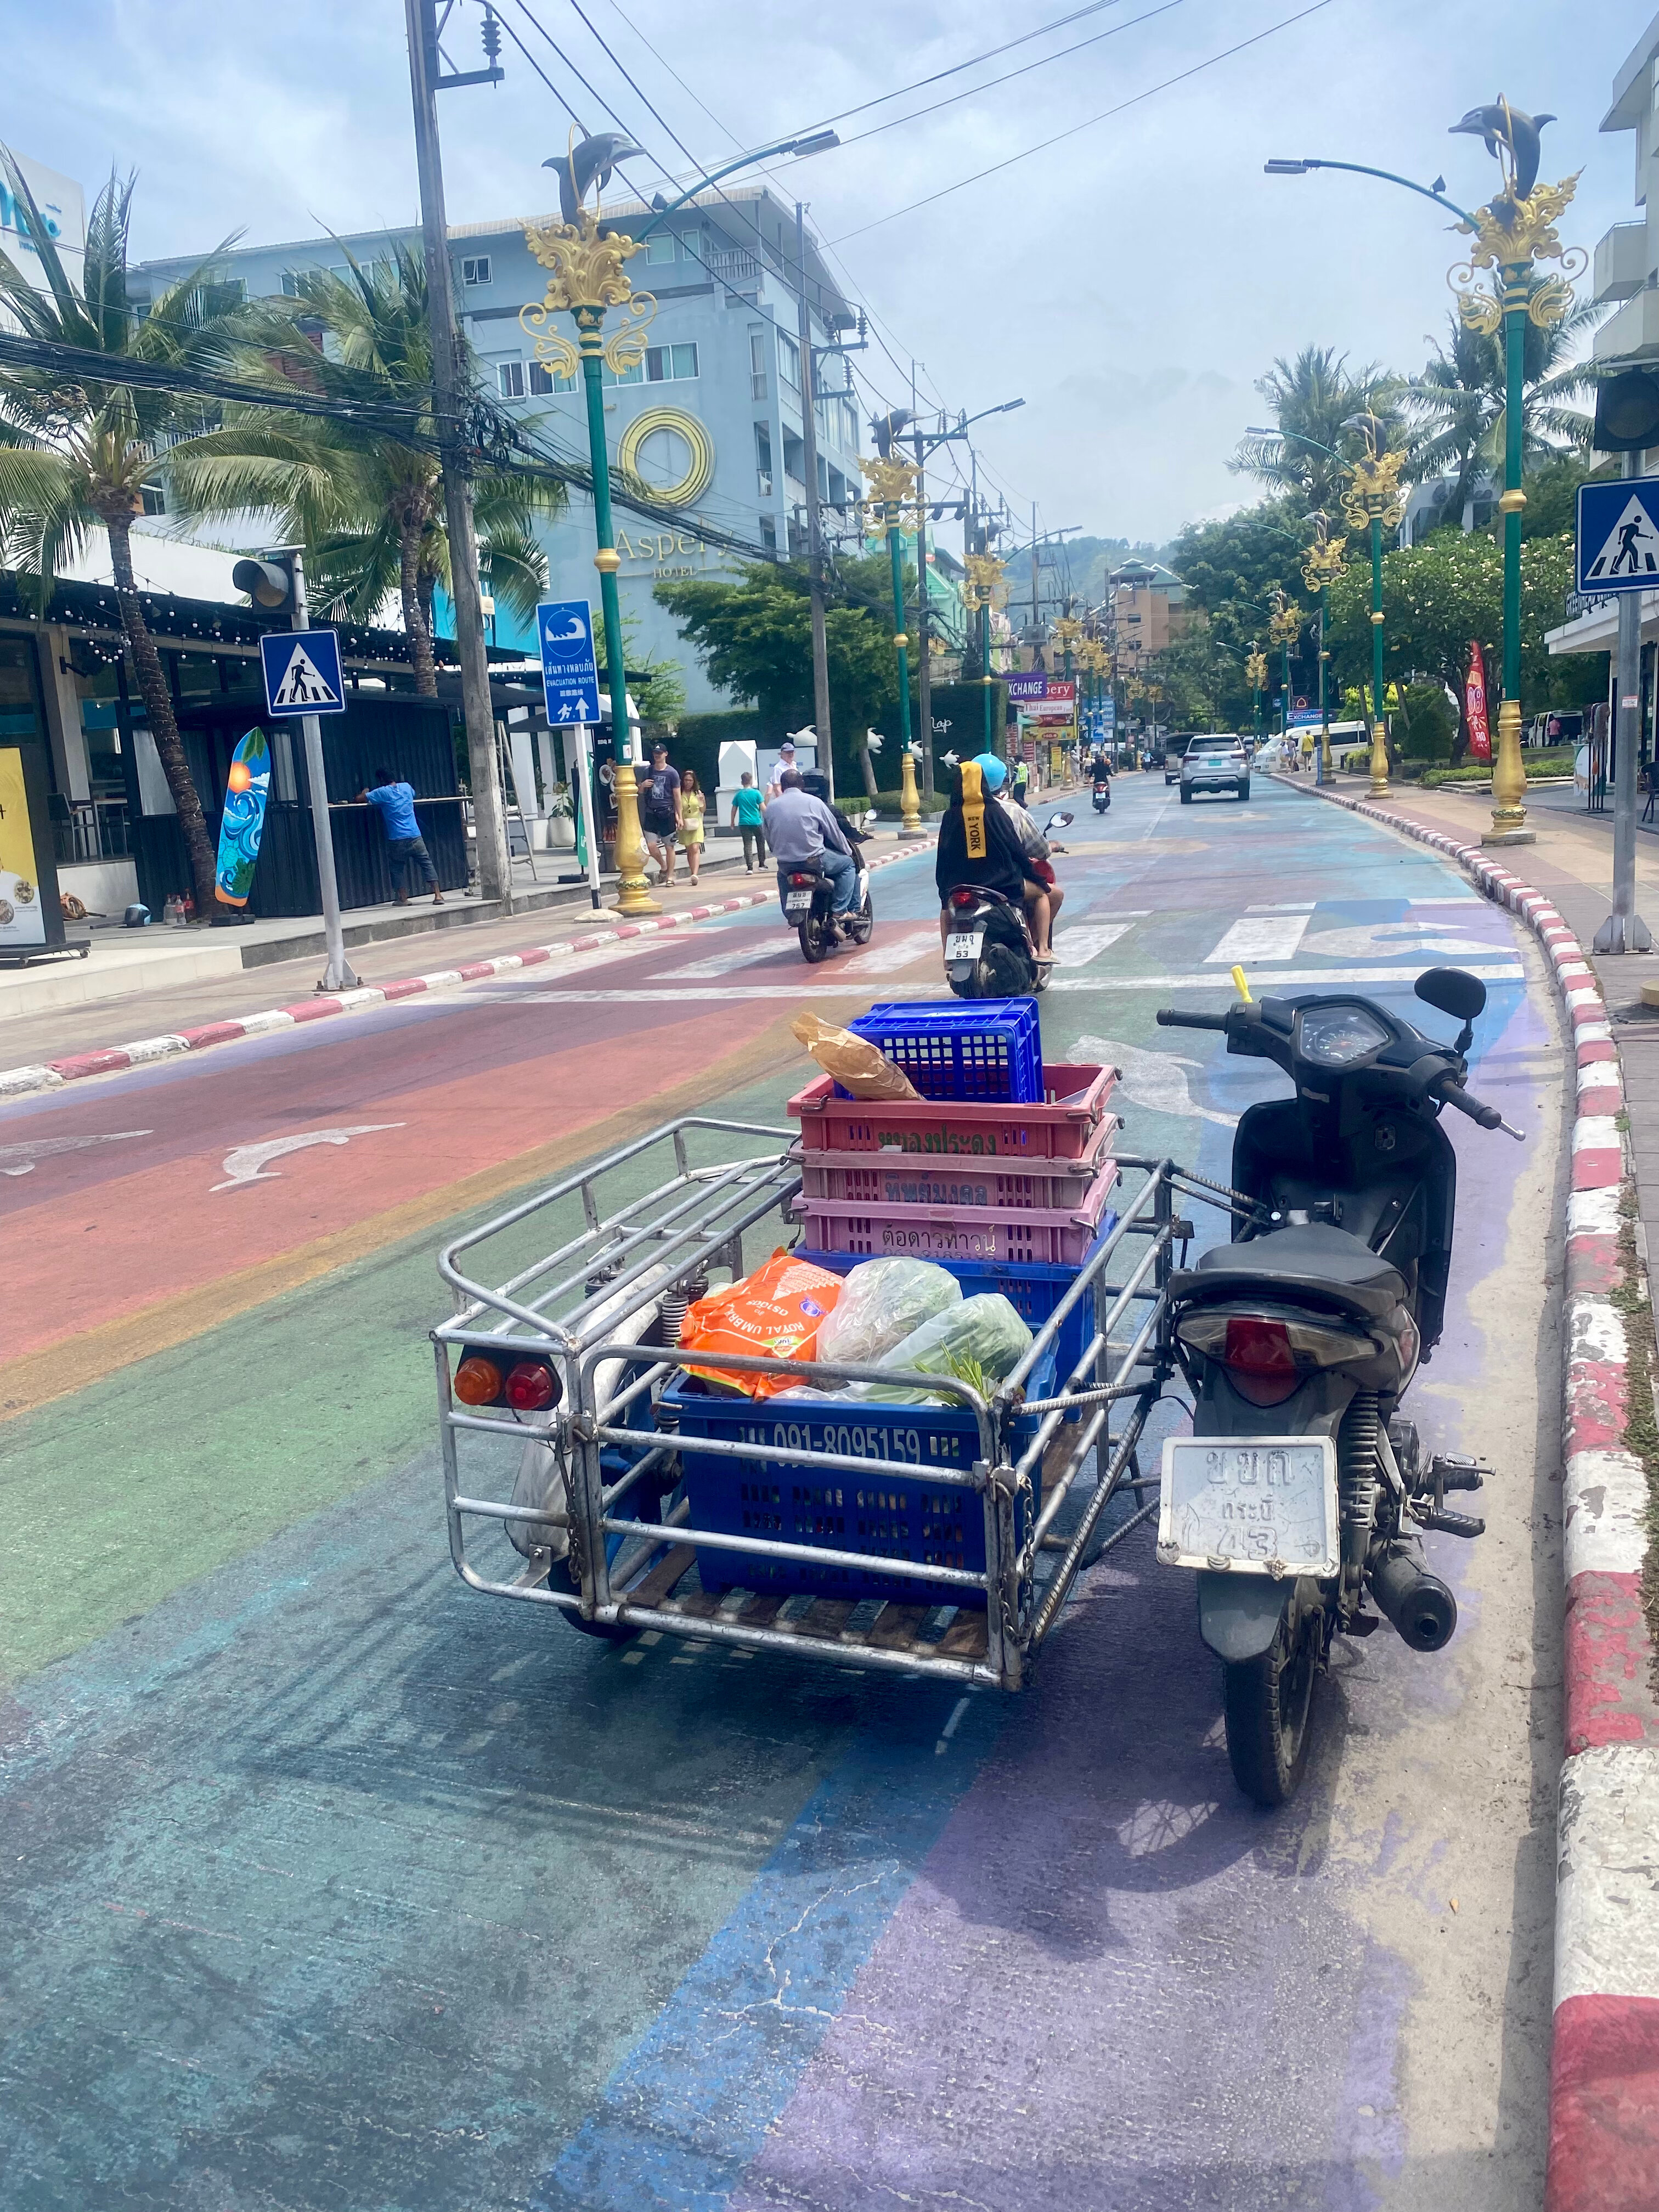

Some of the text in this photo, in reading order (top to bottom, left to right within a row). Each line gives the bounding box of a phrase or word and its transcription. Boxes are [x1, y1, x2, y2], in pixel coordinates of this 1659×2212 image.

[653, 566, 697, 578] HOTEL
[545, 658, 593, 675] เส้นทางหลบภัย
[546, 676, 595, 687] EVACUATION ROUTE
[1025, 703, 1039, 712] Thai
[1040, 704, 1063, 713] European
[969, 822, 981, 851] YORK
[766, 1321, 805, 1335] ROYAL
[774, 1423, 921, 1468] 091-8095159
[1216, 1525, 1278, 1561] 43
